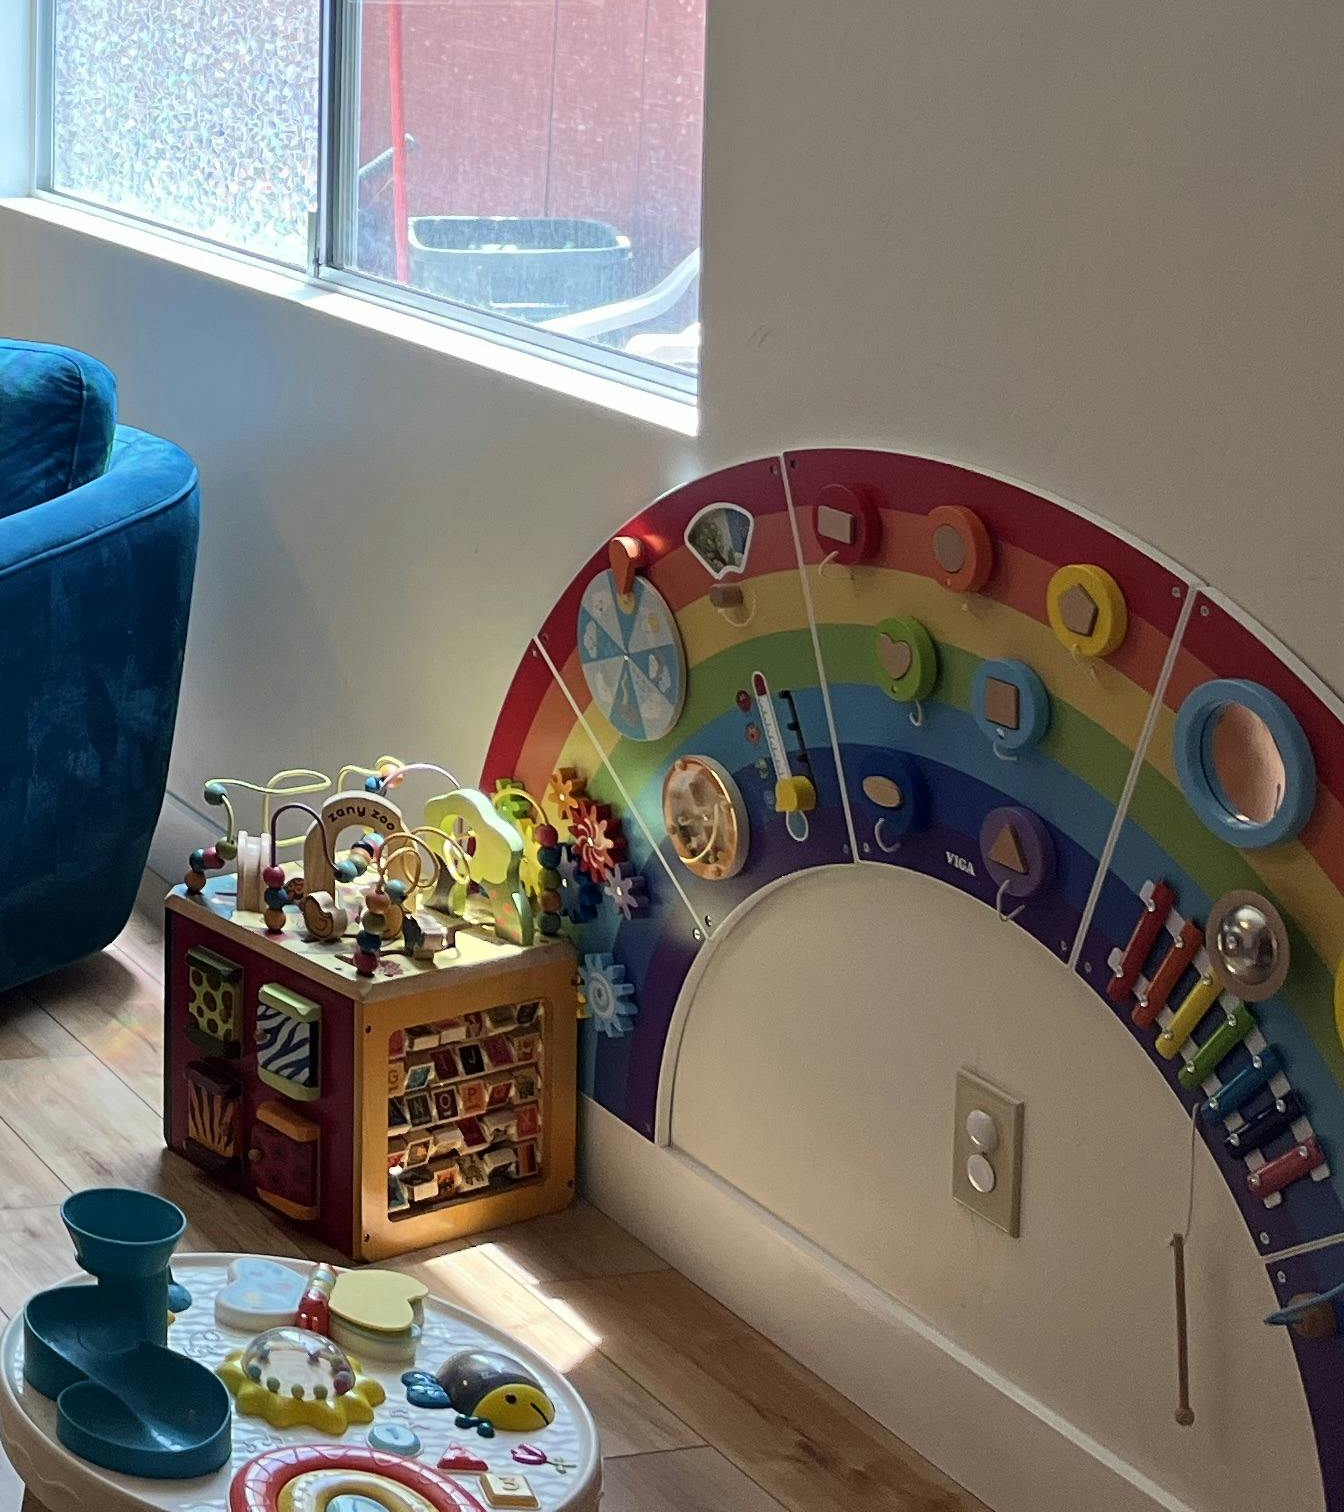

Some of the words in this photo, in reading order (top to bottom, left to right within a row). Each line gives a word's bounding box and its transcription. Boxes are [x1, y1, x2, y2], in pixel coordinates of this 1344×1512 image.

[327, 805, 366, 823] zany
[371, 809, 395, 831] zoo
[945, 851, 977, 877] VIGA
